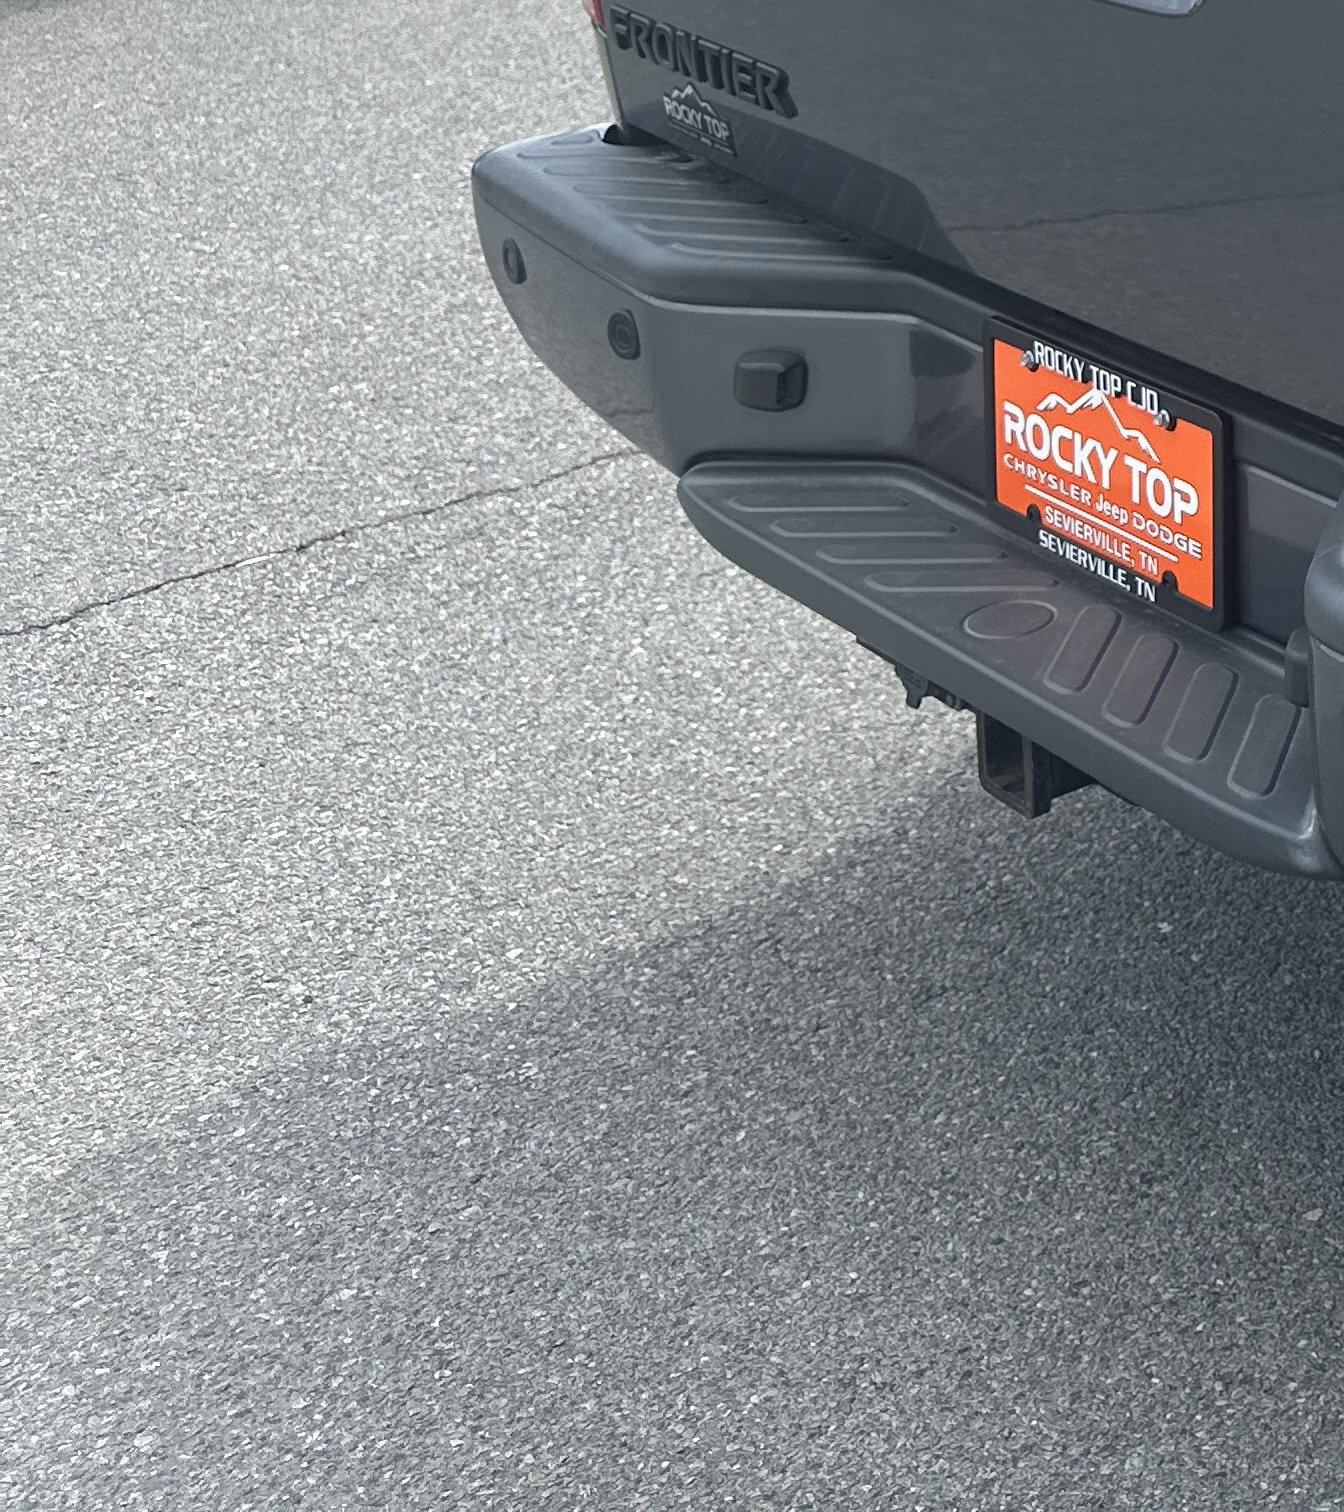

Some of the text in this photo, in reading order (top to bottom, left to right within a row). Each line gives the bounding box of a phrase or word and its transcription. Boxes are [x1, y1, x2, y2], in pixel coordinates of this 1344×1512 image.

[610, 4, 799, 119] FRONTIER
[663, 95, 702, 129] ROCKY
[703, 114, 730, 141] TOP
[1034, 340, 1159, 415] ROCKY TOP CJD
[1003, 400, 1200, 525] ROCKY TOP
[1003, 453, 1203, 559] CHRYSLER Jeep DODGE
[1044, 506, 1159, 575] SEVIERVILLE, TN
[1038, 529, 1157, 602] SEVIERVILLE, TN
